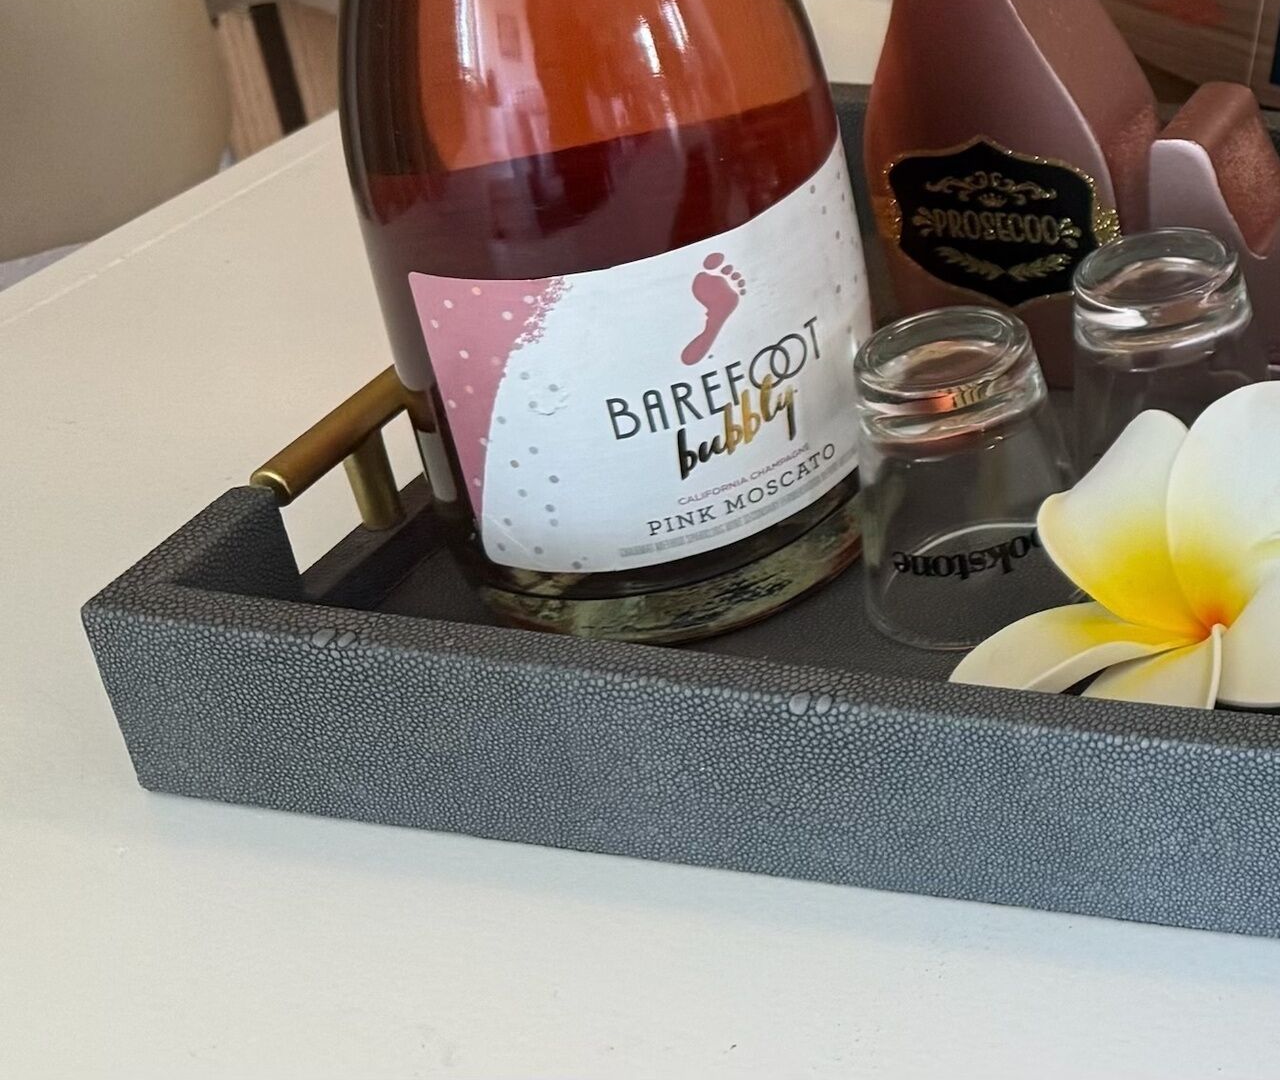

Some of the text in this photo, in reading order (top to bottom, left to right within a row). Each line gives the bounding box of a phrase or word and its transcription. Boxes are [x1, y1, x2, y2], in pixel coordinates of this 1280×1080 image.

[933, 209, 1059, 248] PROSECCO
[605, 316, 821, 441] BAREFOOT
[677, 373, 799, 480] bubbly
[646, 504, 717, 536] PINK
[725, 442, 836, 515] MOSCATO
[677, 442, 811, 506] CALIFORNIA CHAMPAGNE
